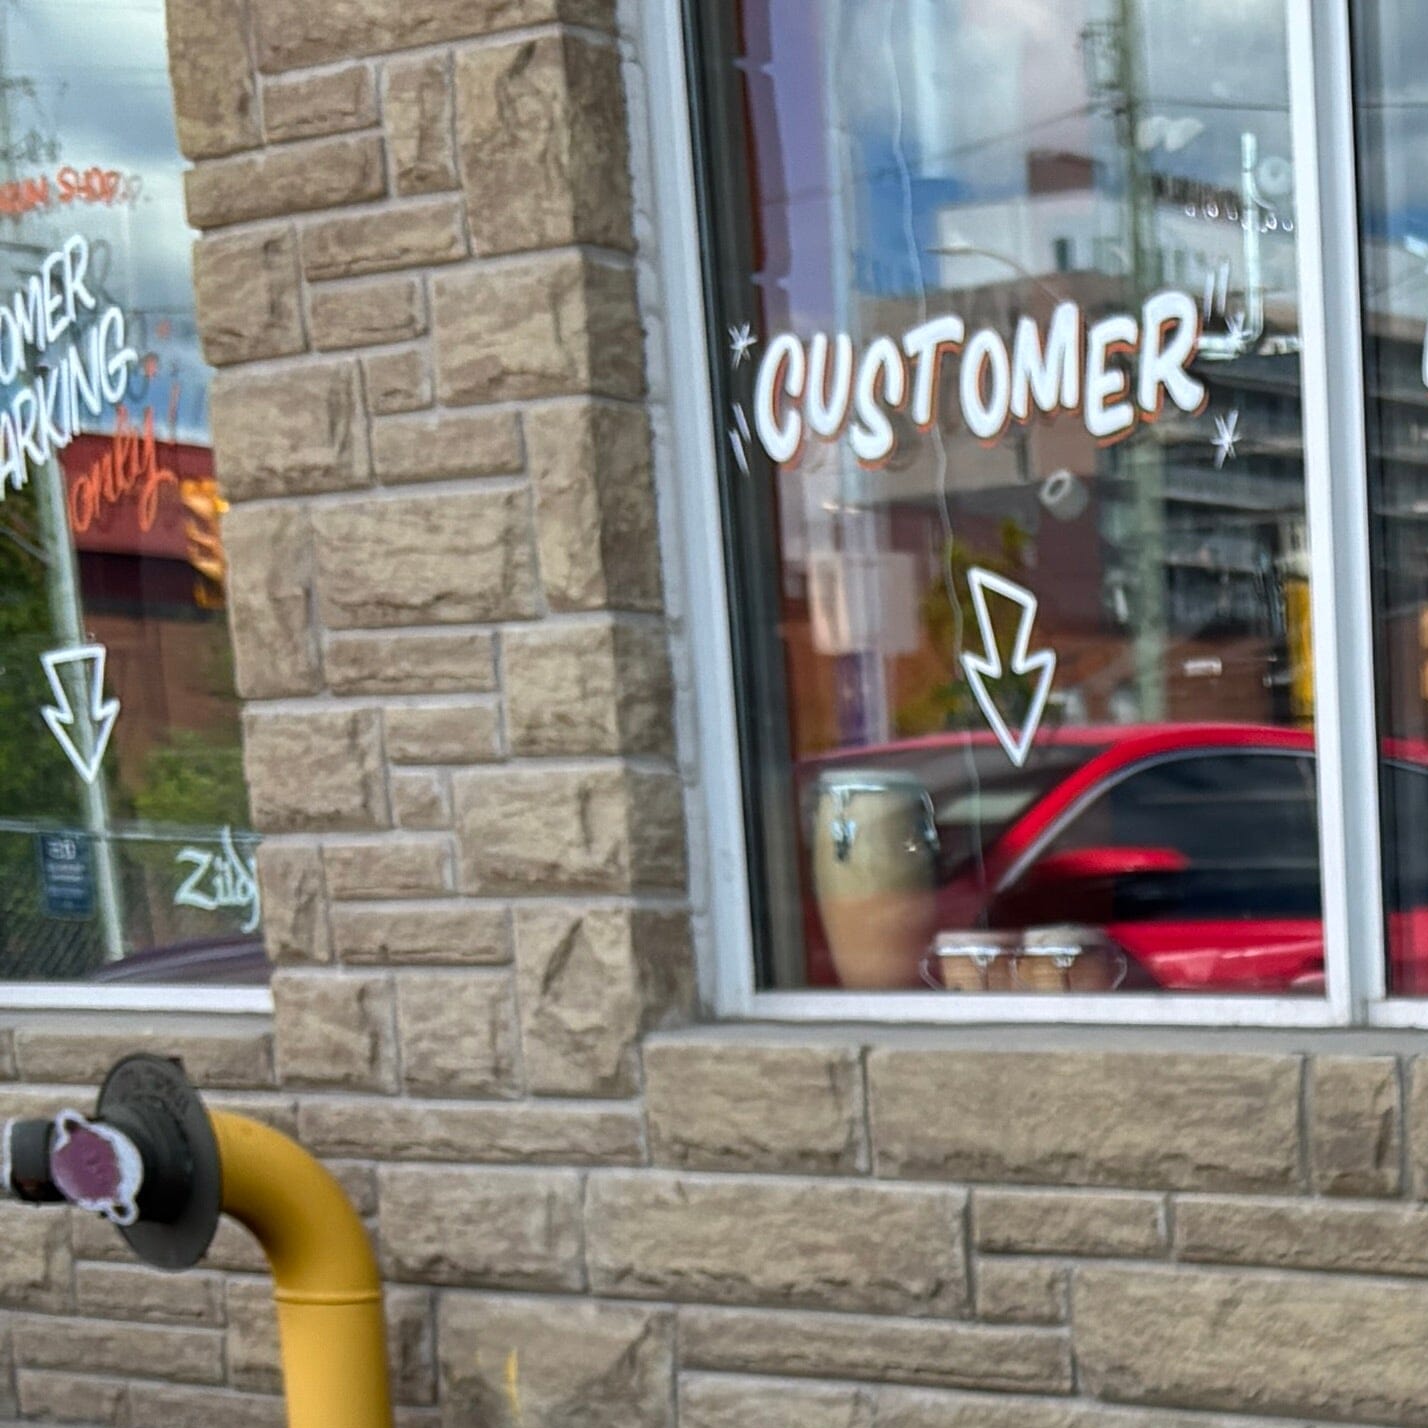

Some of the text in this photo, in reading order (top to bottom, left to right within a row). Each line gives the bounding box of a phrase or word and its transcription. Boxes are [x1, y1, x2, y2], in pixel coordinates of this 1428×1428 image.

[0, 234, 96, 386] OMER
[754, 291, 1207, 470] CUSTOMER
[0, 305, 138, 501] ARKING
[174, 825, 261, 934] Zildj
